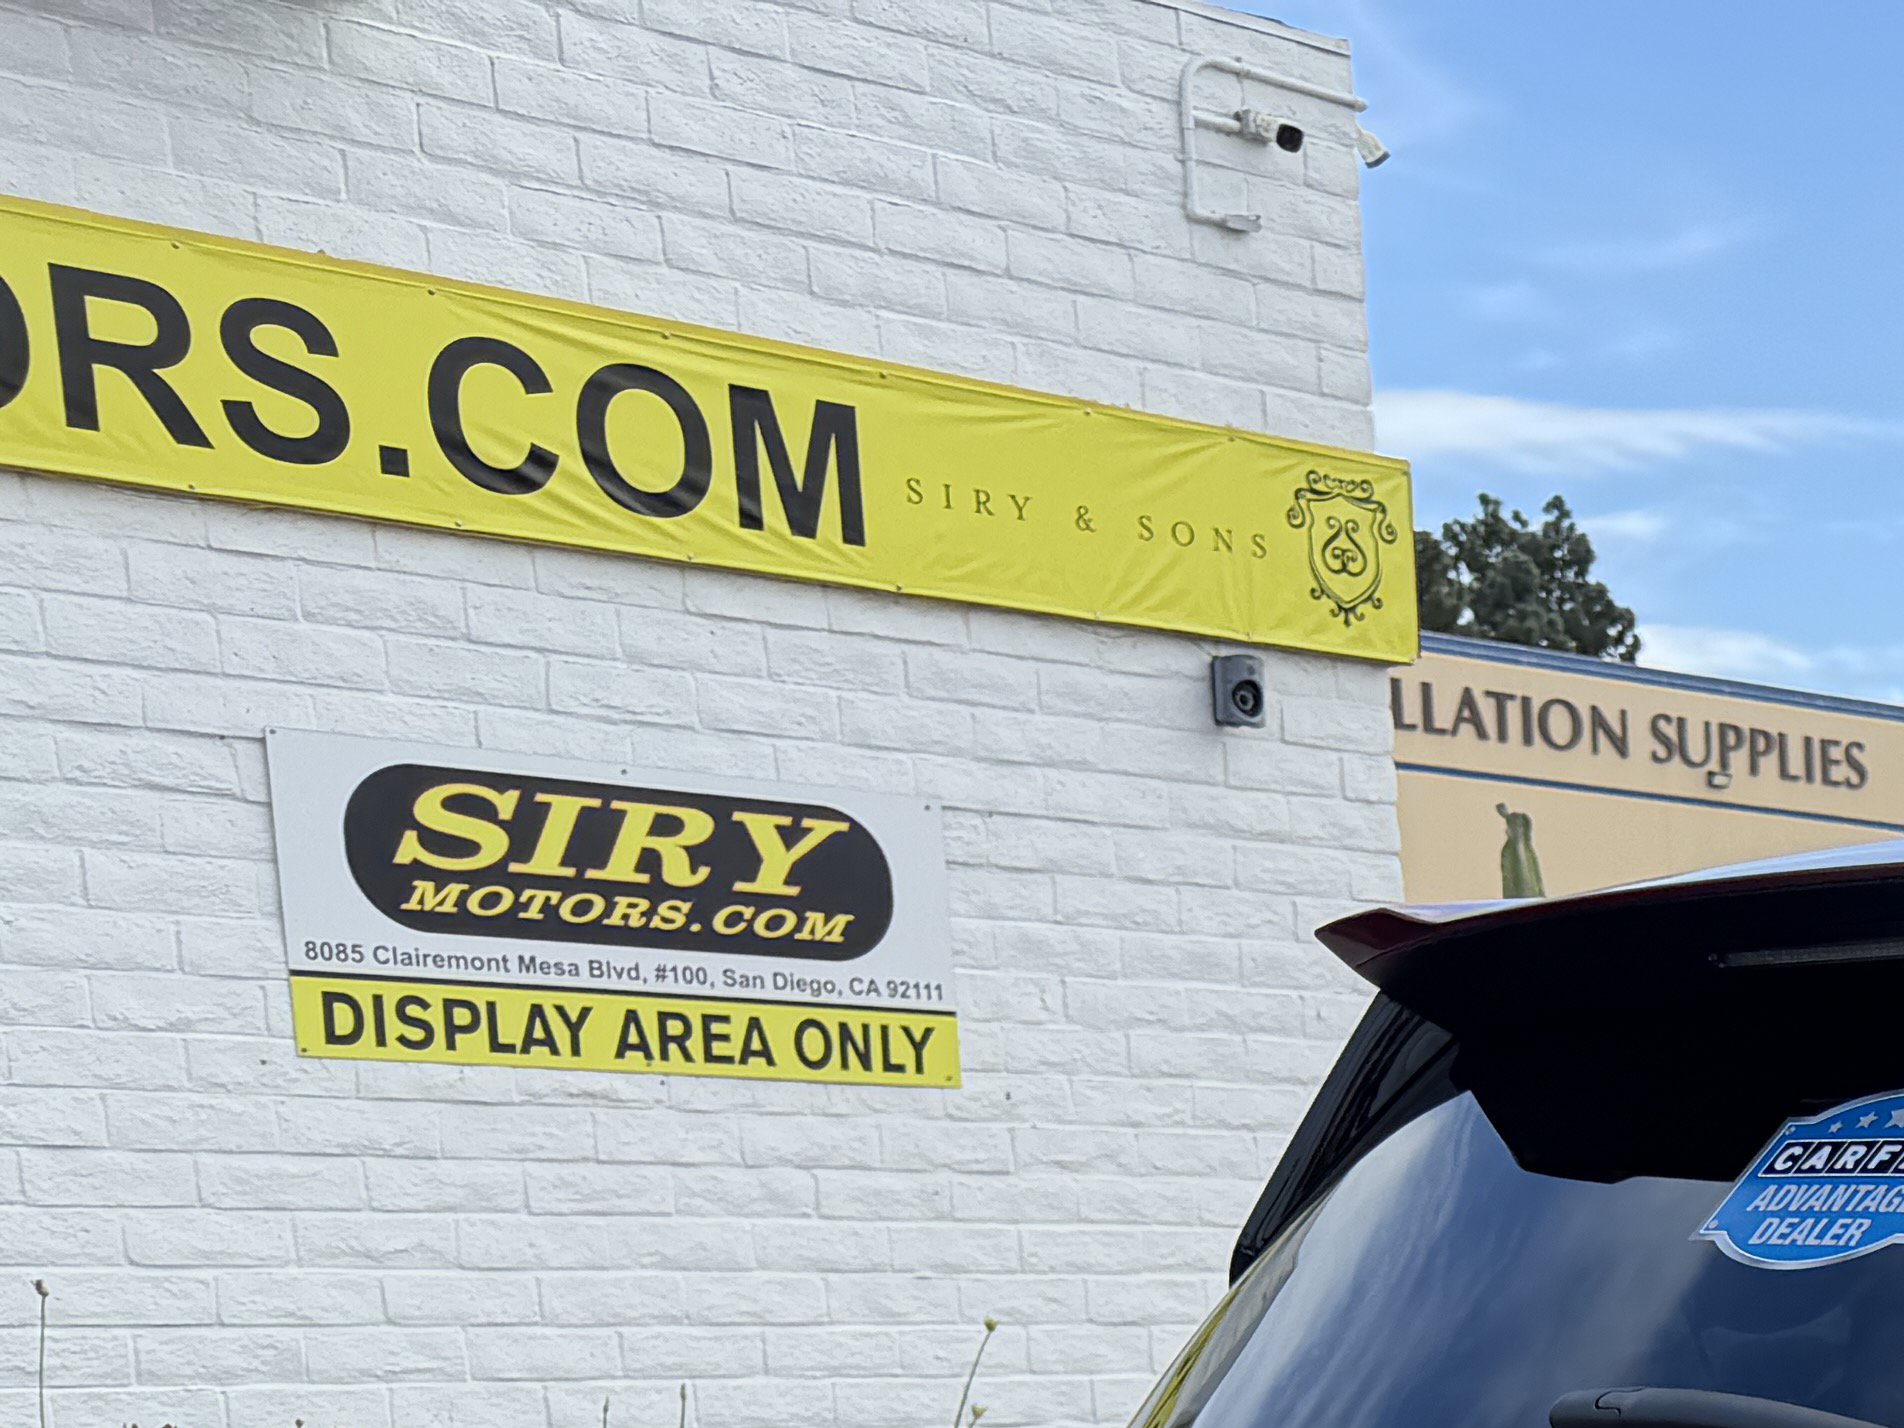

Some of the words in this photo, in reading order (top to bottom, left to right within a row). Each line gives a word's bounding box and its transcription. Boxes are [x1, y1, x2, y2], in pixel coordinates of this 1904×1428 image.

[0, 262, 865, 546] RS.COM
[907, 478, 1032, 521] SIRY
[1075, 505, 1097, 532] &
[1138, 515, 1268, 559] SONS
[1650, 713, 1868, 790] SUPPLIES
[392, 783, 849, 898] SIRY
[399, 880, 854, 943] MOTORS.COM
[304, 940, 365, 964] 8085
[372, 944, 511, 974] Clairemont
[518, 955, 580, 978] Mesa
[588, 959, 648, 983] Blvd,
[654, 964, 715, 989] #100,
[722, 968, 765, 991] San
[772, 971, 843, 998] Diego,
[848, 977, 886, 997] CA
[886, 979, 943, 1001] 92111
[321, 990, 594, 1057] DISPLAY
[614, 1008, 777, 1067] AREA
[794, 1018, 935, 1075] ONLY
[1749, 1217, 1873, 1247] DEALER
